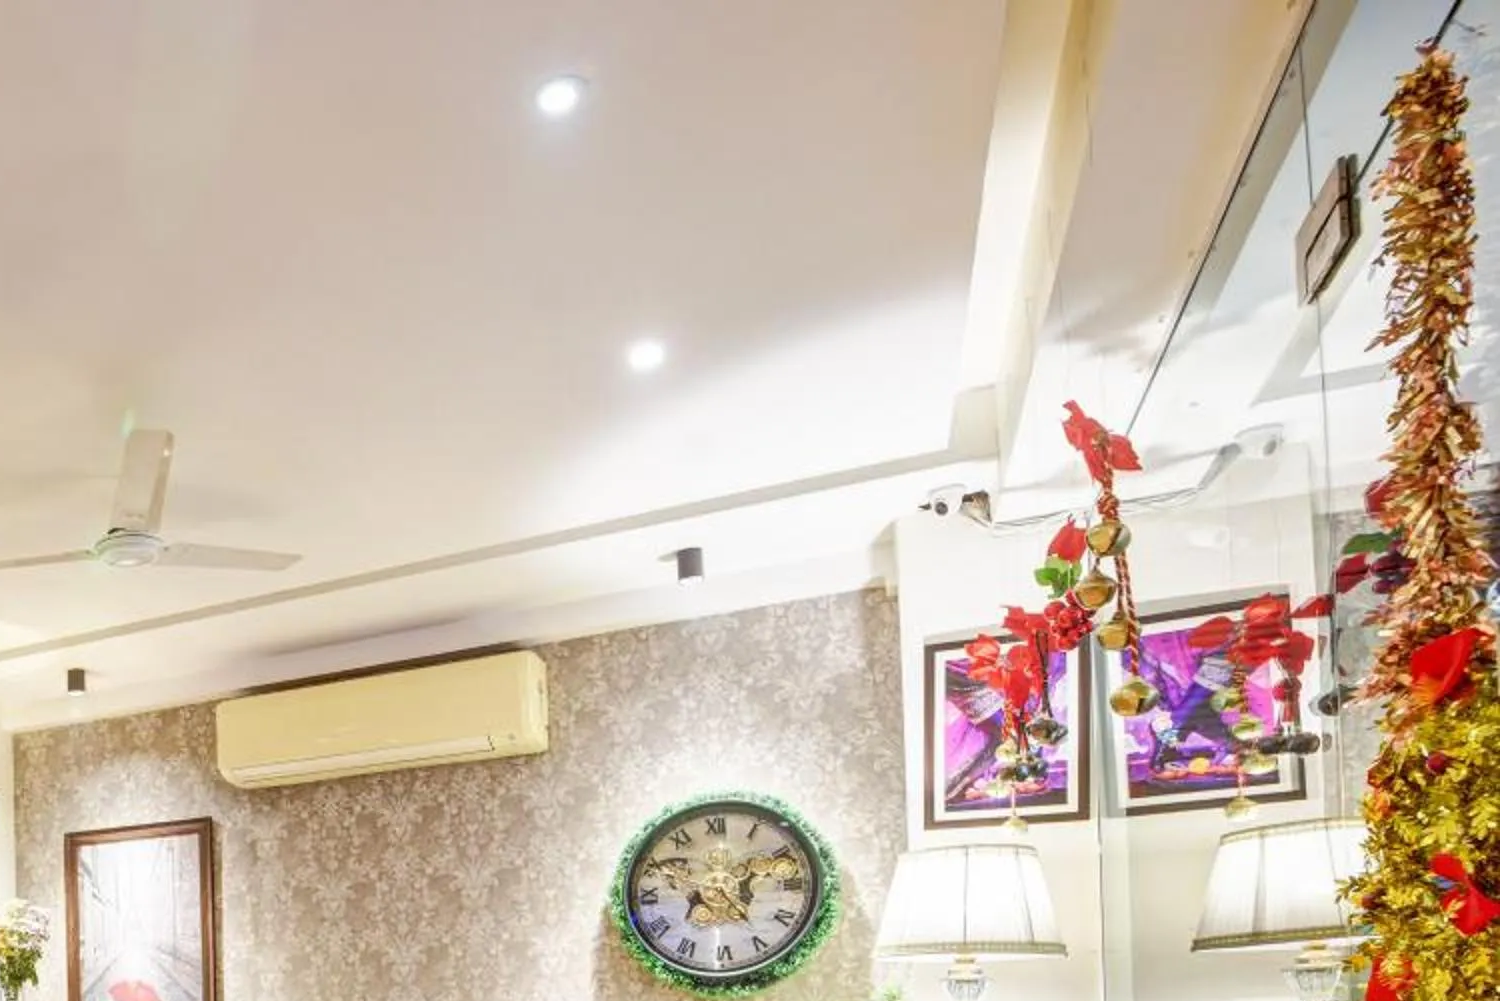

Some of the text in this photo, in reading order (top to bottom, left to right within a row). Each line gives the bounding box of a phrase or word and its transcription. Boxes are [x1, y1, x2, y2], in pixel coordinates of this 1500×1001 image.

[705, 817, 726, 834] XII
[669, 829, 692, 849] XI
[783, 878, 802, 891] III
[640, 887, 658, 905] IX
[717, 945, 733, 960] VI
[752, 935, 768, 953] V
